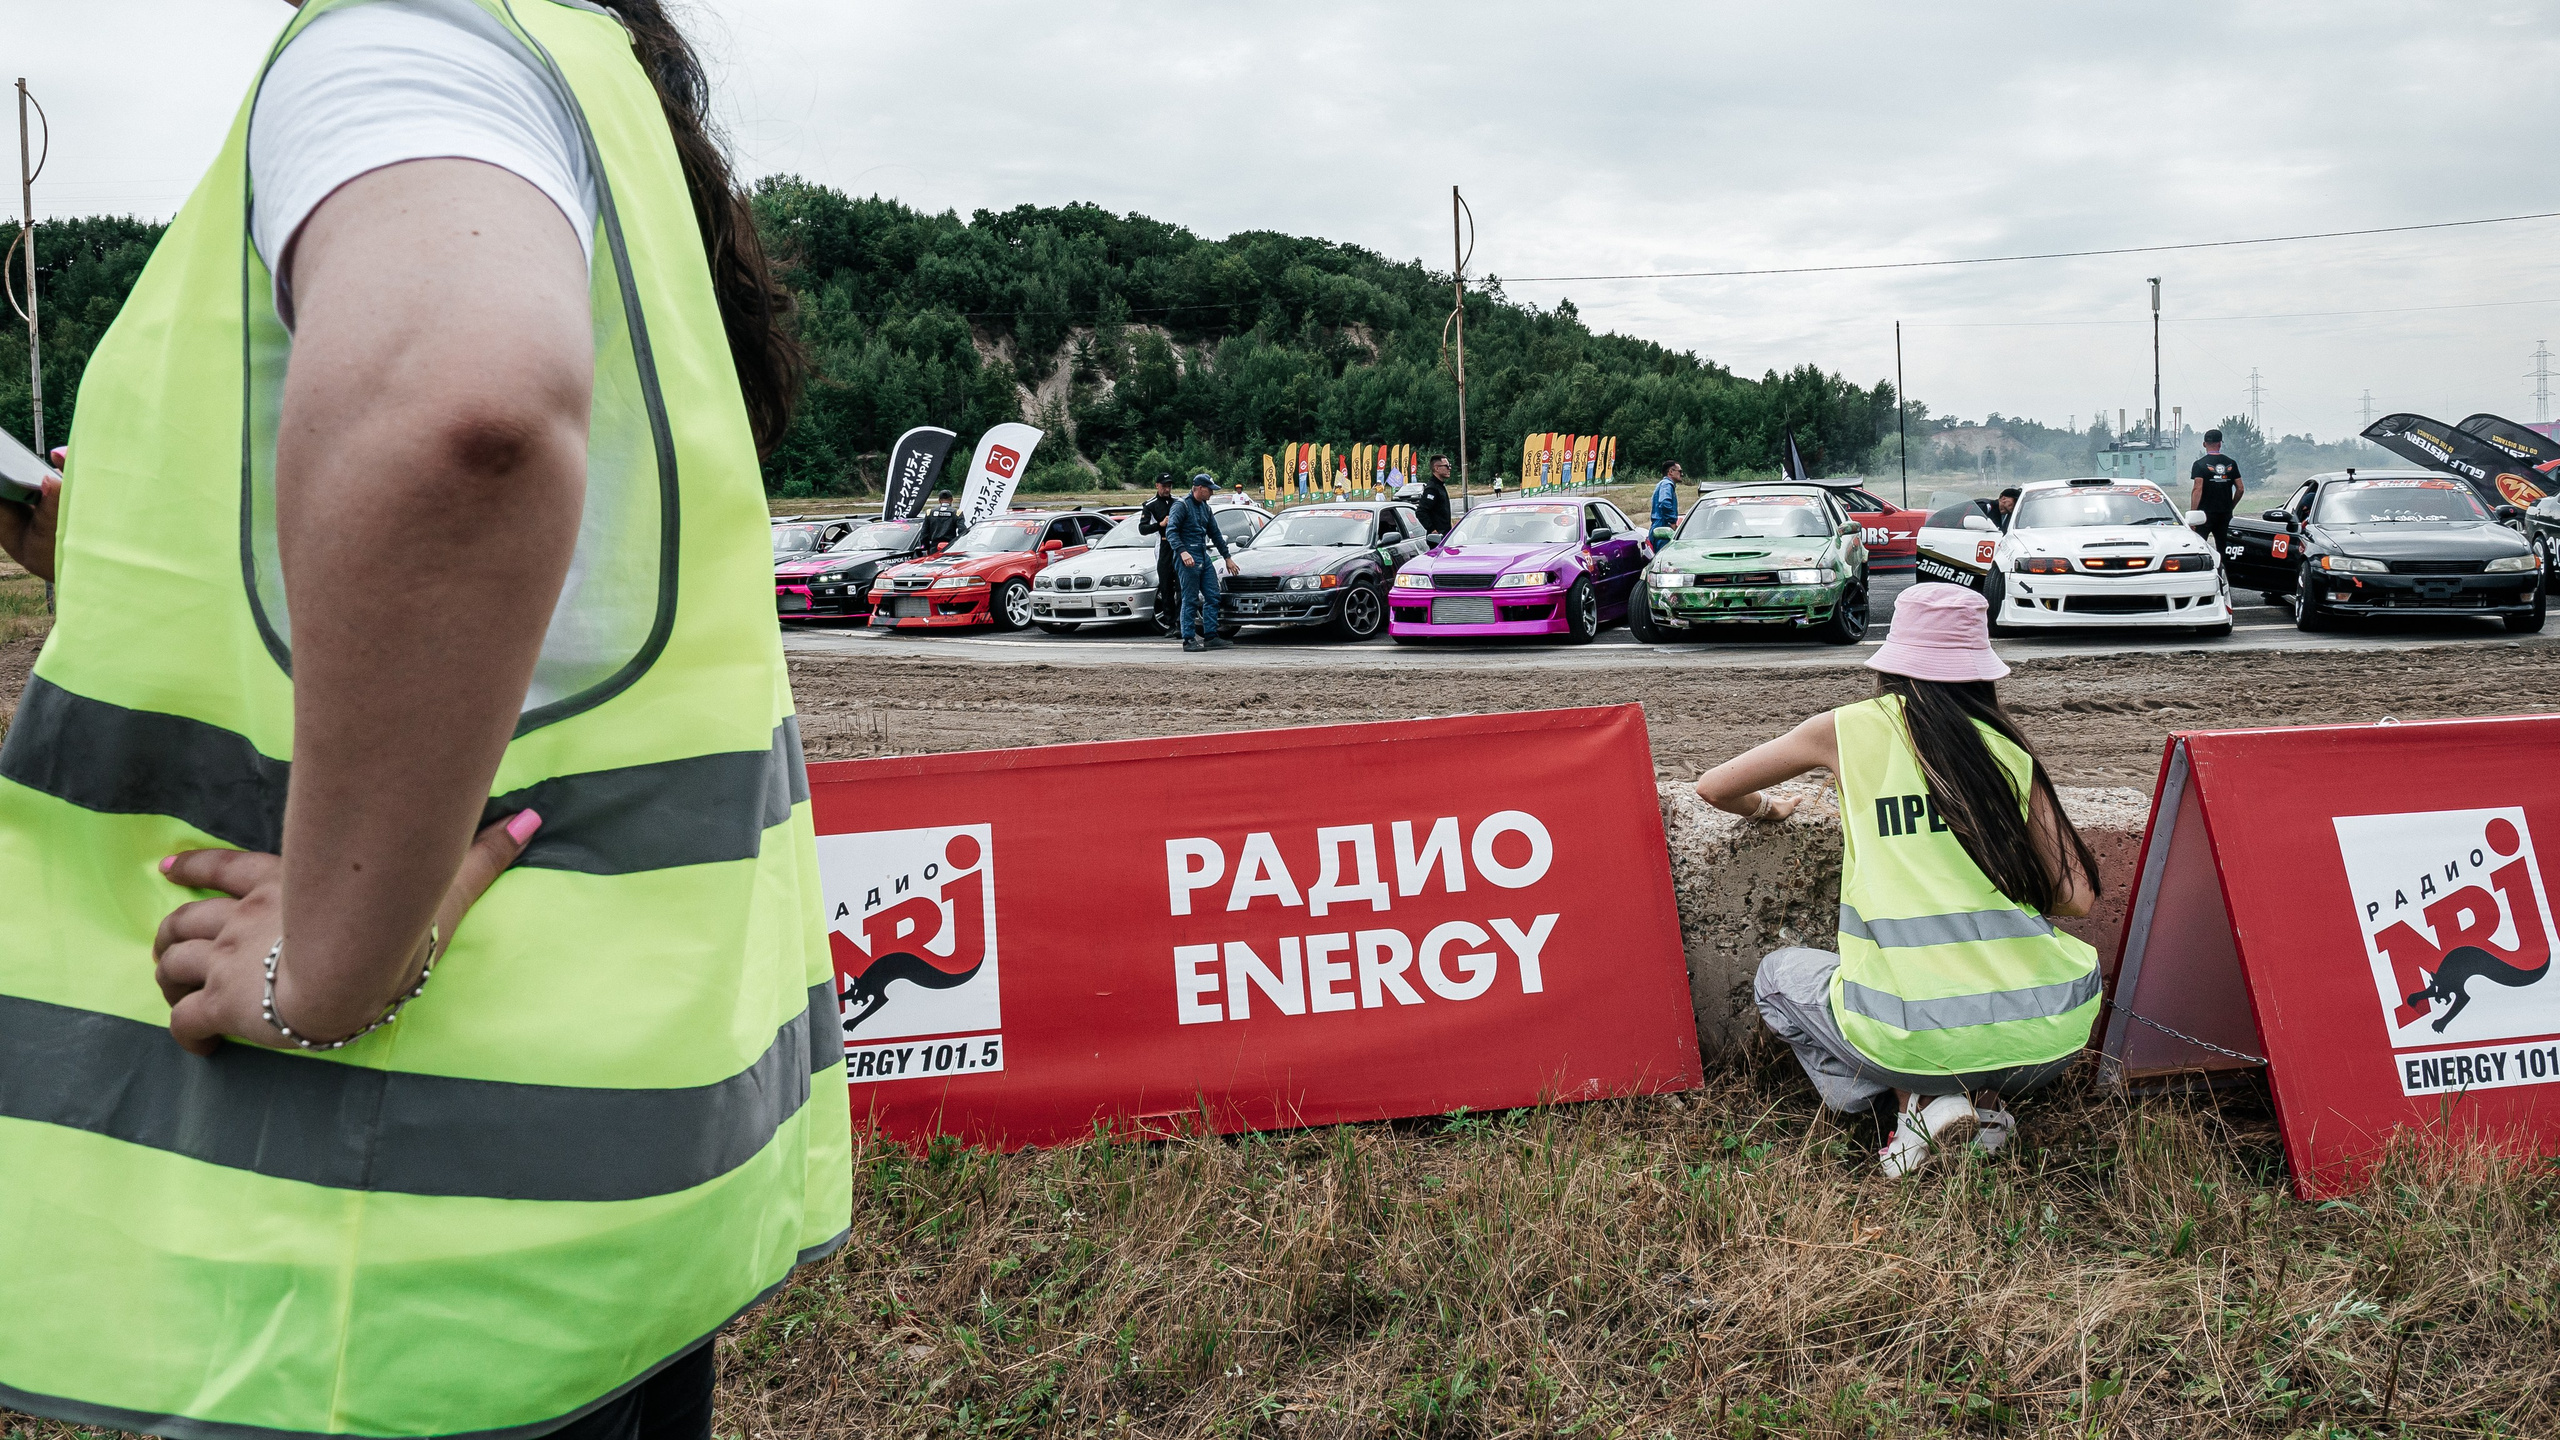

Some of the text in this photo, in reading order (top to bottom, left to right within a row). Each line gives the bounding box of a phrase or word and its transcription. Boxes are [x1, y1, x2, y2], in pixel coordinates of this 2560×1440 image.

[2404, 431, 2449, 463] WESTERN
[2491, 434, 2518, 449] DISTANCE
[2518, 443, 2529, 452] THE
[918, 453, 934, 485] JAPAN
[988, 450, 1015, 472] FQ
[2450, 459, 2486, 480] GULF
[987, 480, 1007, 516] JAPAN
[1977, 545, 1994, 558] FQ
[2273, 539, 2288, 553] FQ
[1165, 810, 1554, 917] РАДИО
[834, 862, 939, 921] АДИО
[2366, 848, 2484, 922] РАДИО
[1173, 912, 1561, 1025] ENERGY
[921, 1041, 999, 1072] 101.5
[2405, 1052, 2507, 1090] ENERGY
